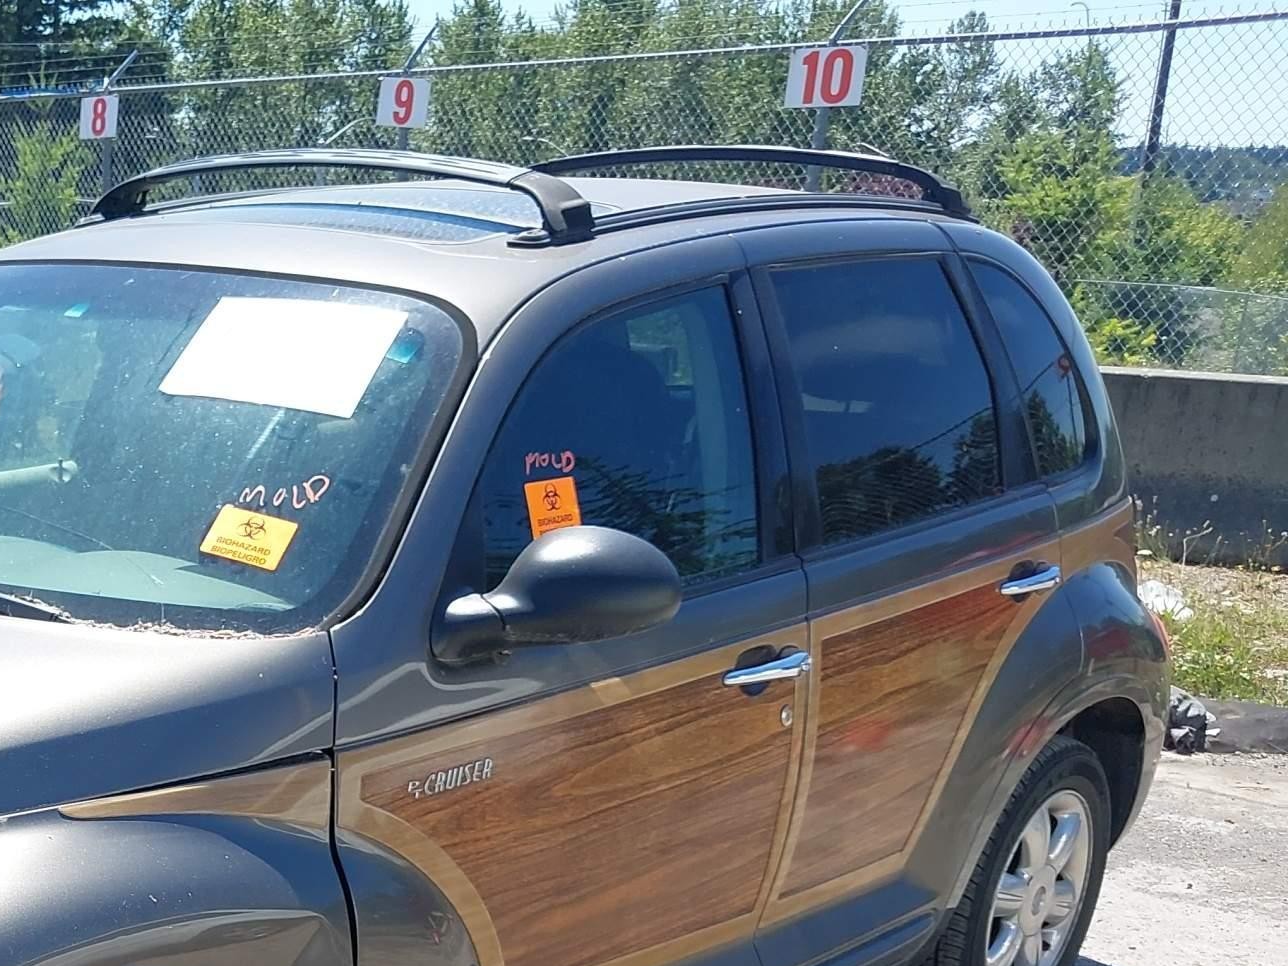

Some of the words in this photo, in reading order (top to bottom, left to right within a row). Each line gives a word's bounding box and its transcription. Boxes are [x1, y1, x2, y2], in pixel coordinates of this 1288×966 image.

[802, 47, 854, 106] 10
[90, 97, 108, 136] 8
[392, 79, 414, 127] 9
[210, 545, 267, 566] BIOPELIGRO
[215, 536, 271, 556] BIOHAZARD
[423, 758, 493, 795] CRUISER
